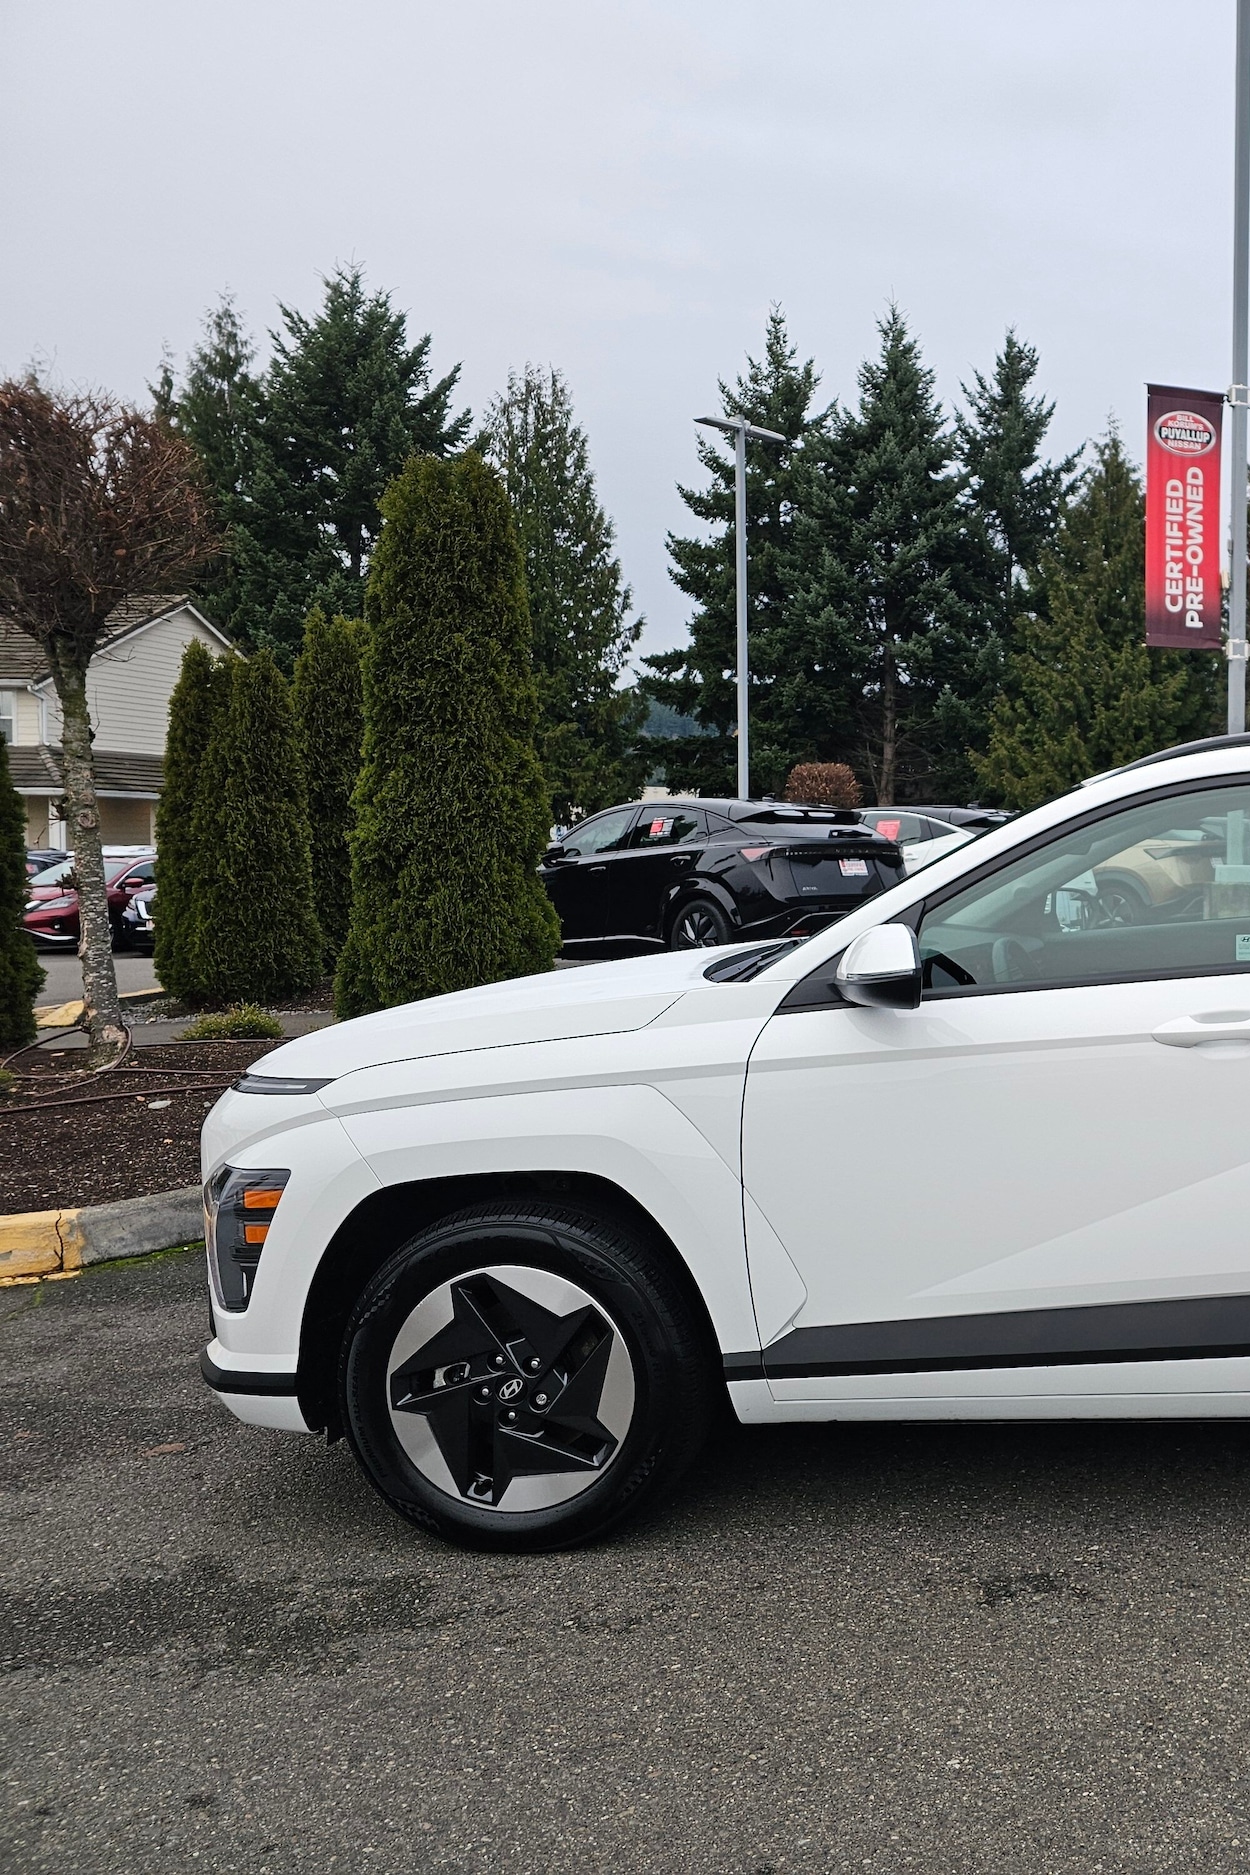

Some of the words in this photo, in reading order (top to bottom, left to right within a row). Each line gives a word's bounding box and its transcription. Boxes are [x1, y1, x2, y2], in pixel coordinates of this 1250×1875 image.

[1167, 420, 1204, 430] KORUM'S
[1161, 427, 1210, 442] PUYALLUP
[1167, 440, 1201, 450] NISSAN
[1165, 479, 1183, 612] CERTIFIED
[1186, 467, 1204, 628] PRE-OWNED
